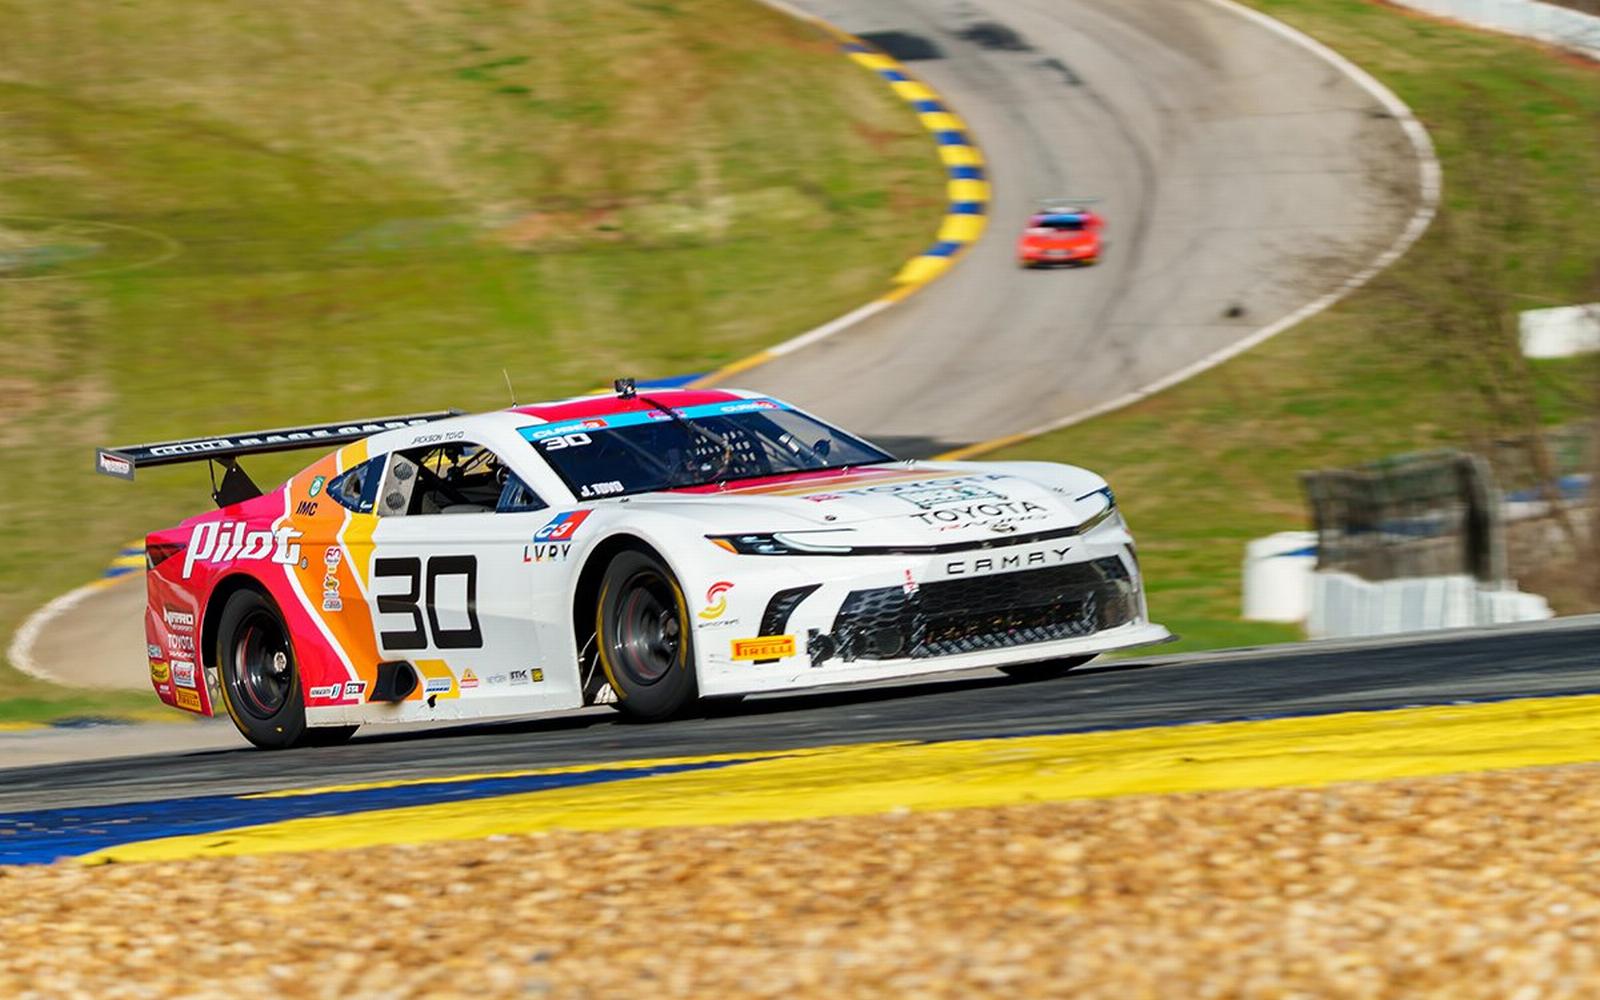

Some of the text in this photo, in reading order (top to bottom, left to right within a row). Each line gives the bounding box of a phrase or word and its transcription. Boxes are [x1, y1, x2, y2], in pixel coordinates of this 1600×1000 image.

[411, 433, 442, 444] JACKSON
[540, 432, 593, 451] 30
[295, 500, 319, 516] IMC
[909, 500, 1048, 525] TOYOTA
[946, 546, 1072, 575] CAMRY
[374, 554, 484, 651] 30
[167, 633, 195, 650] TOYOTA
[735, 639, 793, 657] PIRELLI
